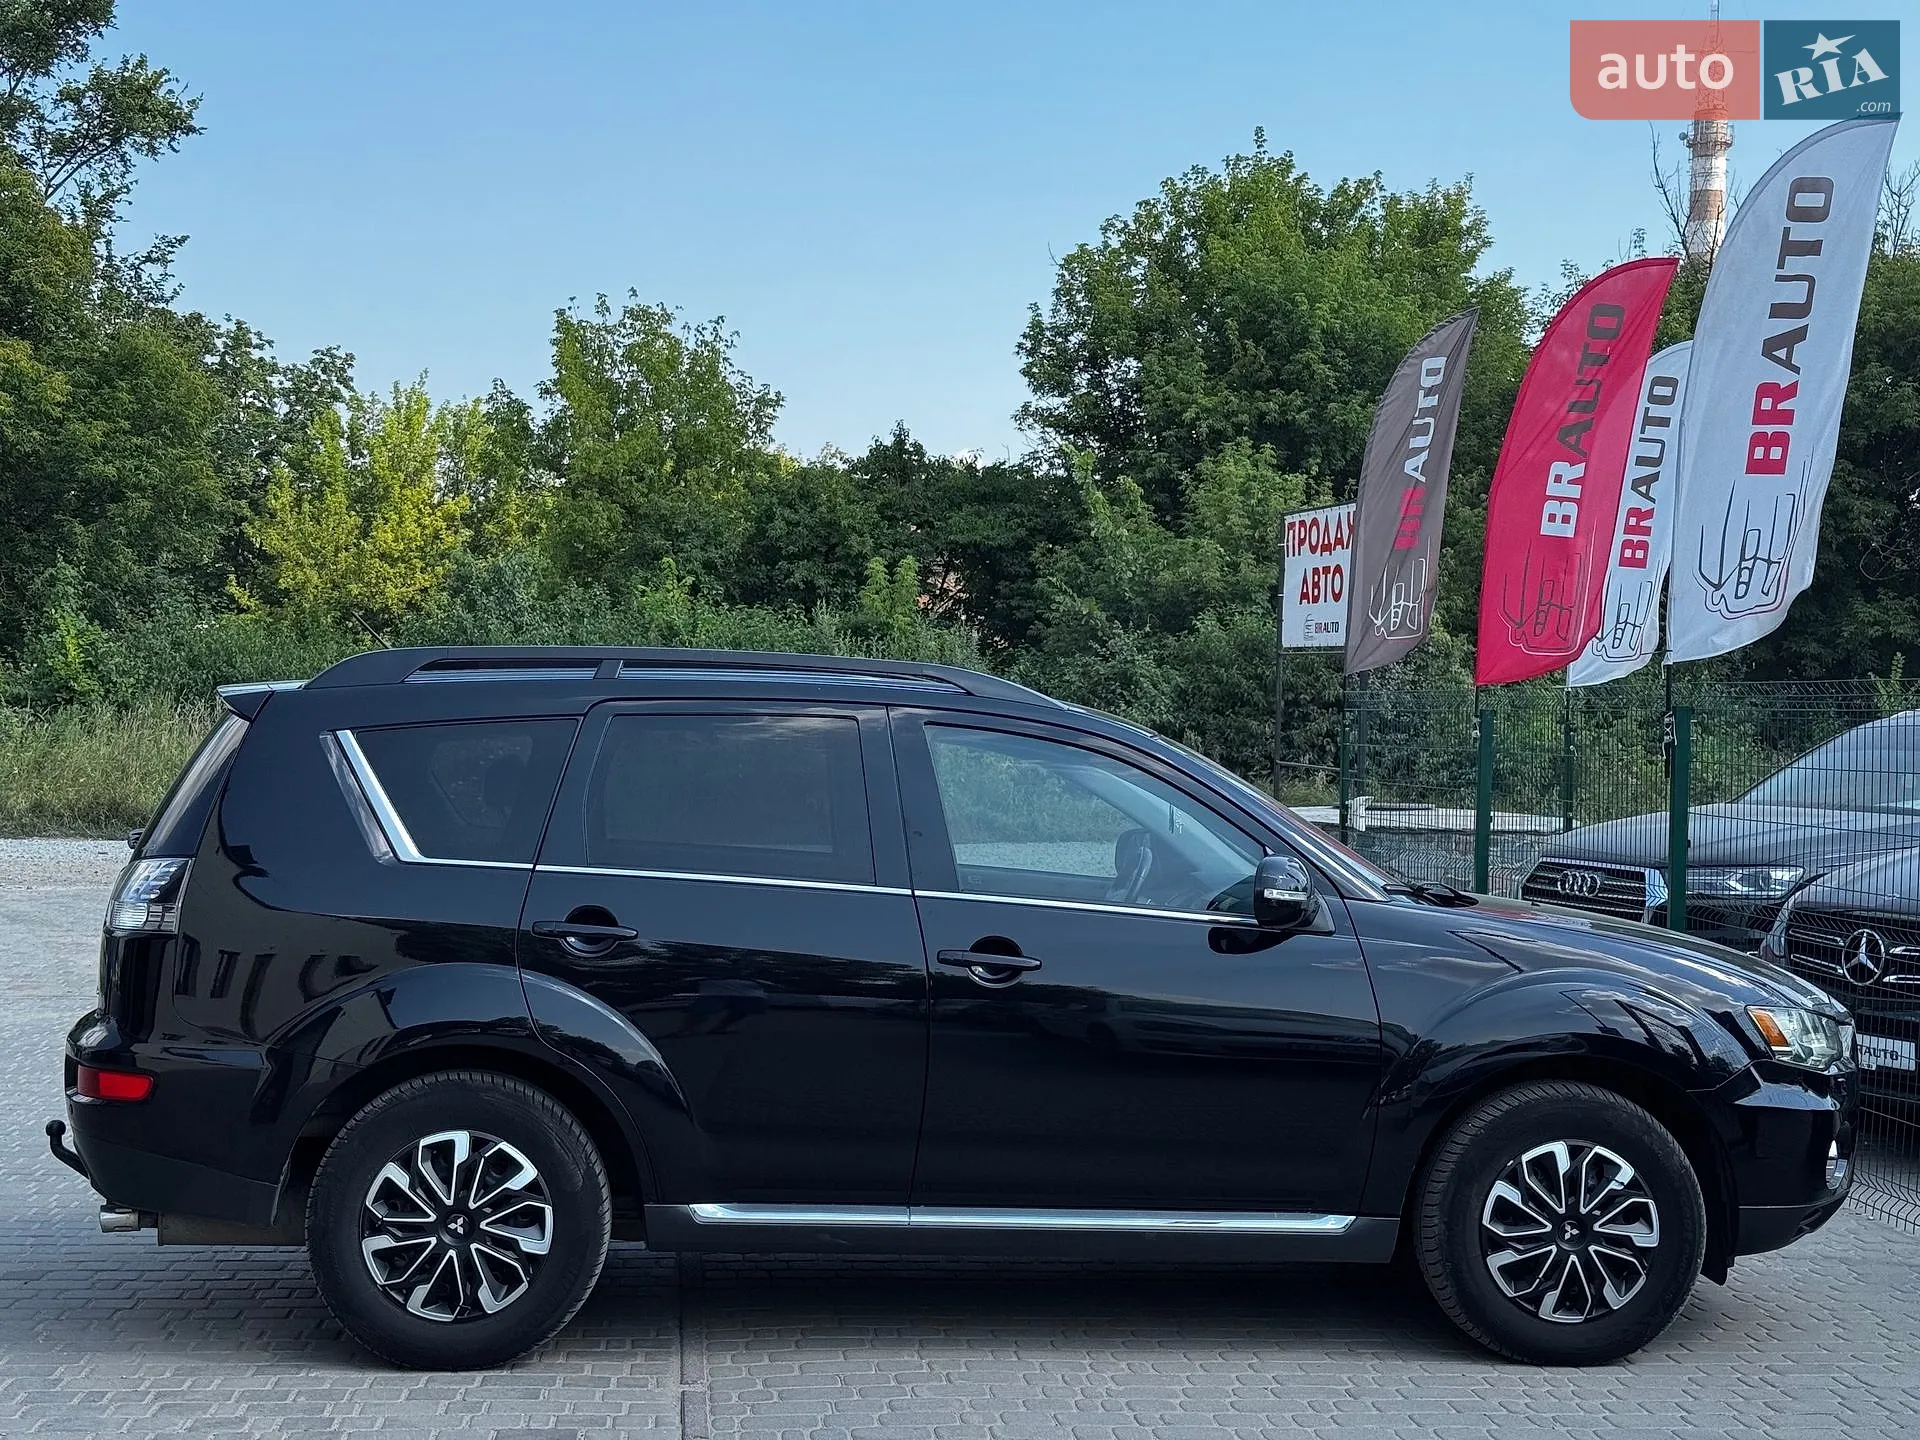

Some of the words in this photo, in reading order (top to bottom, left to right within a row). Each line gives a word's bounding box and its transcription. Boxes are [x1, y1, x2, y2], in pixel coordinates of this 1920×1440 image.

[1540, 303, 1625, 538] BRAUTO
[1745, 176, 1835, 476] BRAUTO
[1393, 356, 1448, 550] BRAUTO
[1618, 375, 1680, 570] BRAUTO
[1299, 563, 1344, 605] АВТО
[1314, 621, 1340, 634] BRAUTO
